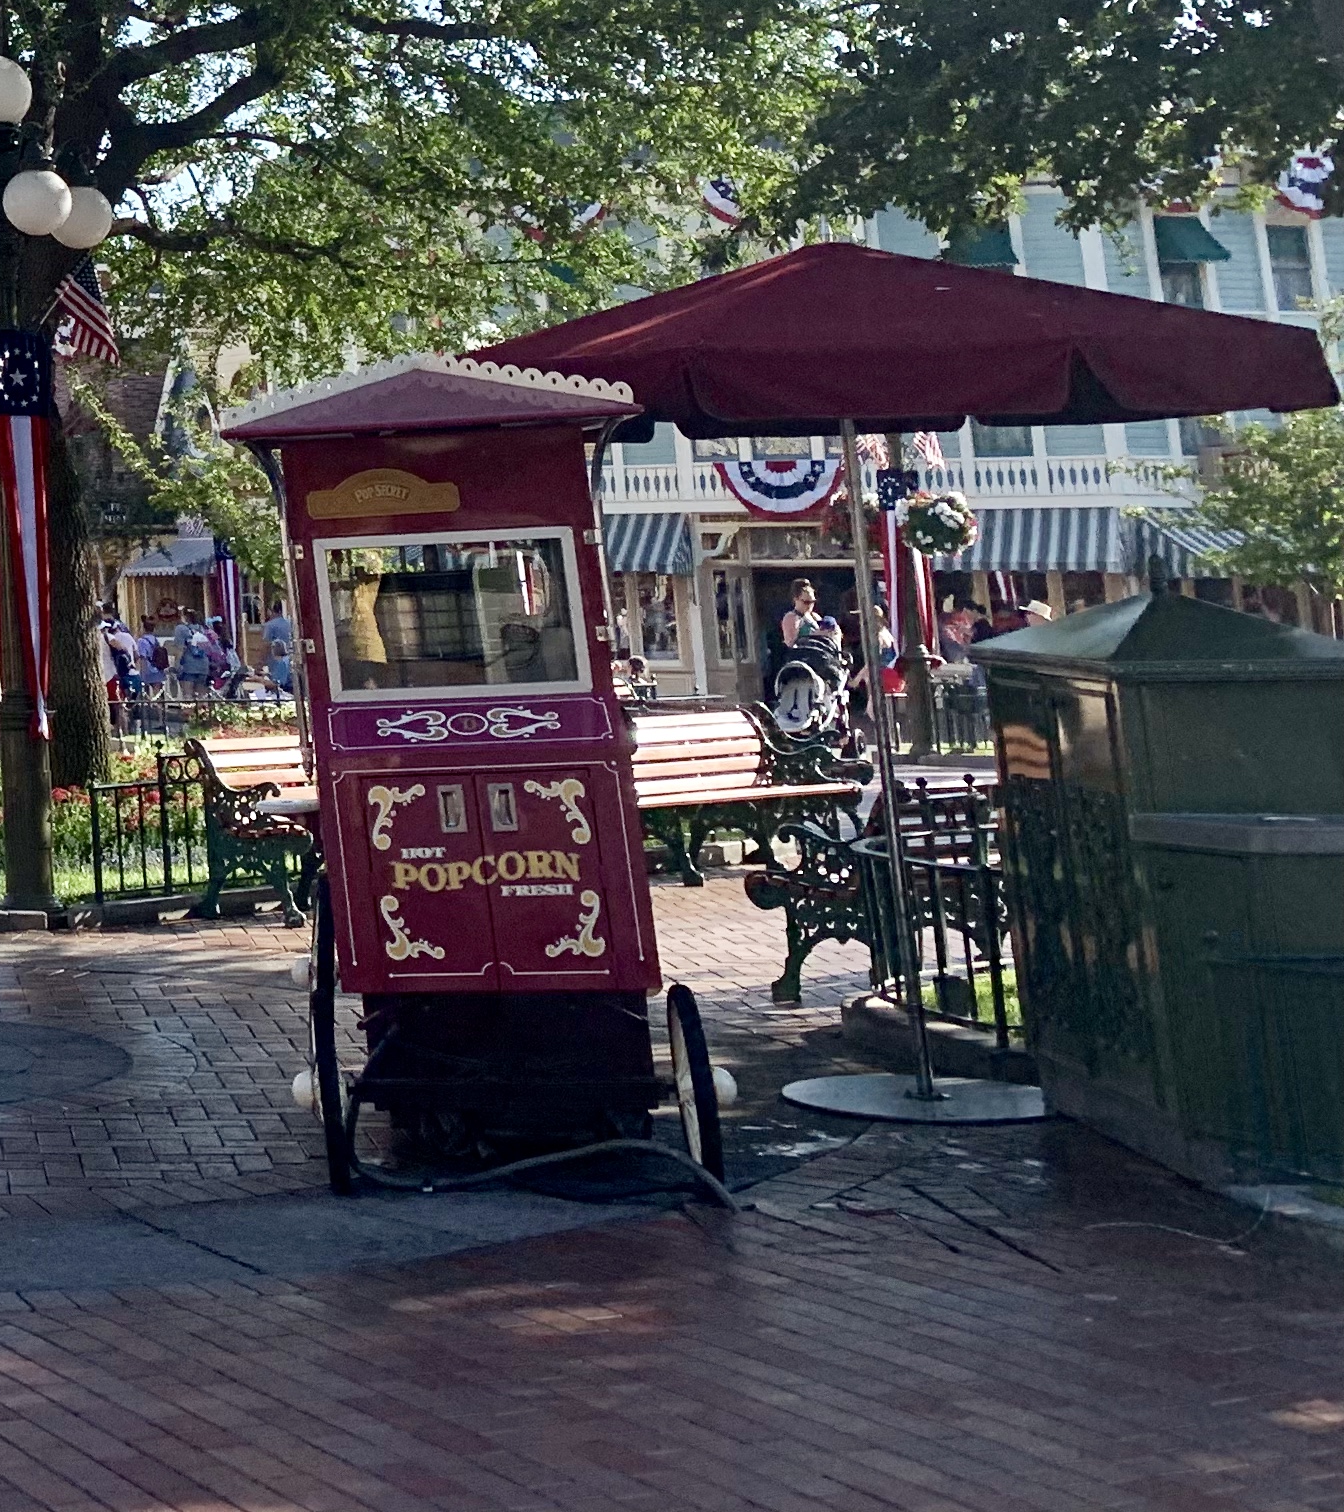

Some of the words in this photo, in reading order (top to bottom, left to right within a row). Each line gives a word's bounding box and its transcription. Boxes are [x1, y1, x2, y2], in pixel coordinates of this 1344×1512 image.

[400, 846, 447, 860] HOT
[389, 849, 582, 893] POPCORN
[500, 883, 575, 897] FRESH
